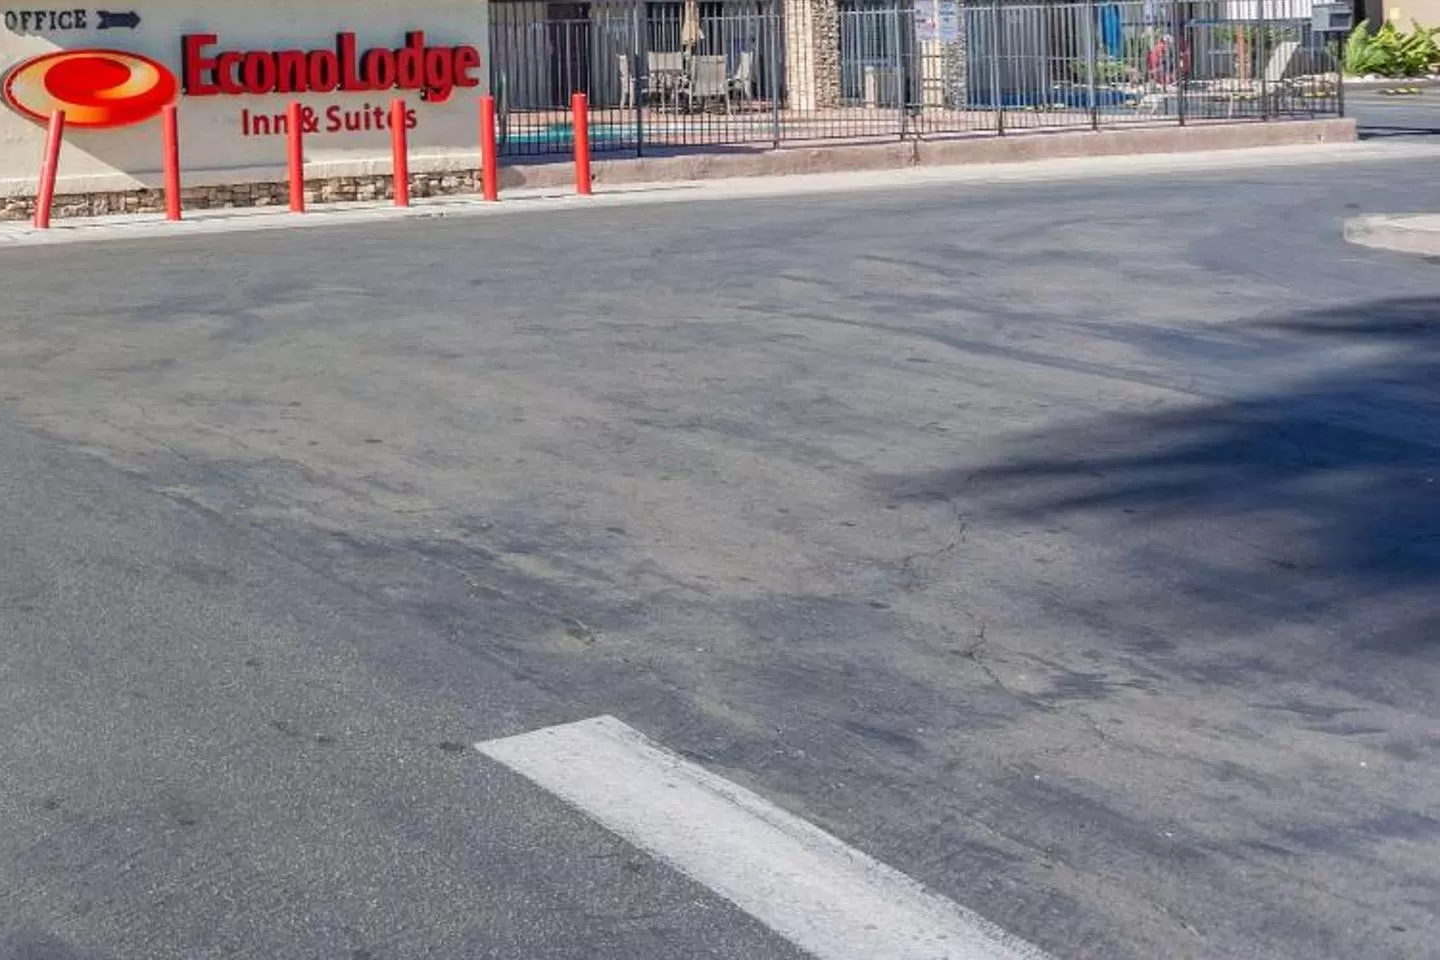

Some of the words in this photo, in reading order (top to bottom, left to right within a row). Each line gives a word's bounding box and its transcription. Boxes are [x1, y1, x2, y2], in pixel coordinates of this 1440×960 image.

[5, 9, 86, 30] OFFICE
[182, 30, 481, 102] EconoLodge
[242, 109, 288, 136] Inn
[301, 106, 319, 133] &
